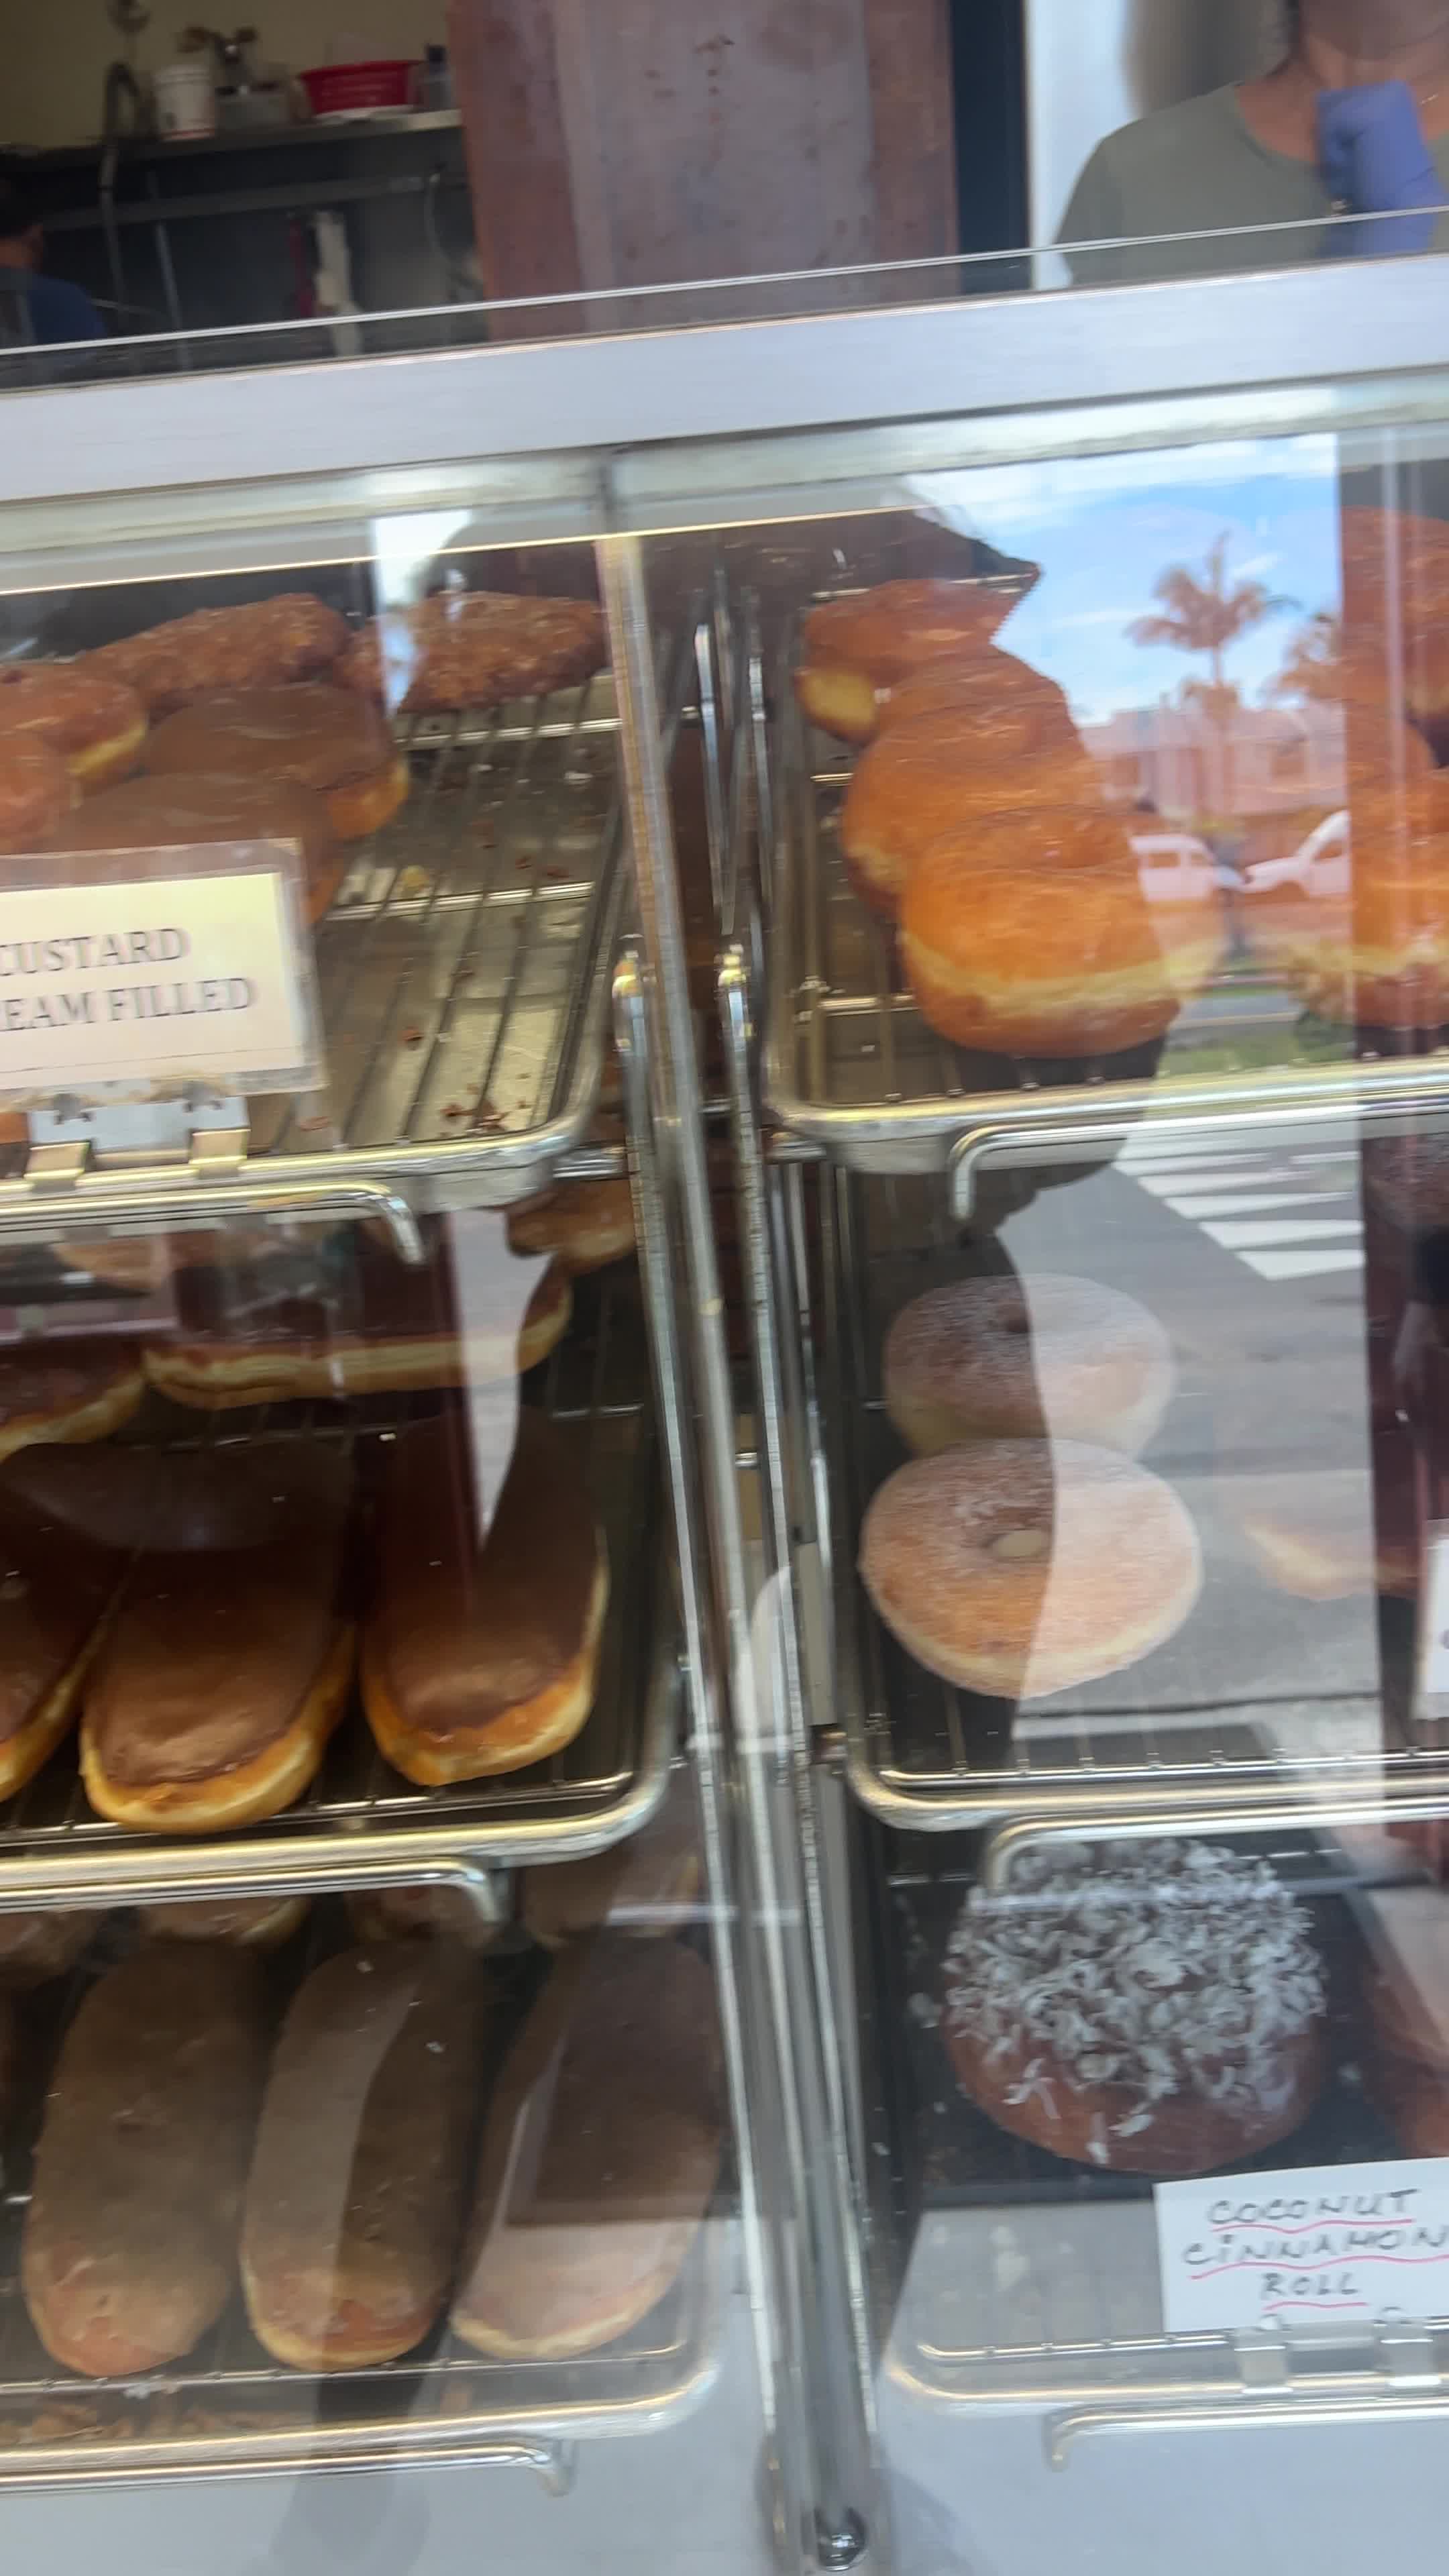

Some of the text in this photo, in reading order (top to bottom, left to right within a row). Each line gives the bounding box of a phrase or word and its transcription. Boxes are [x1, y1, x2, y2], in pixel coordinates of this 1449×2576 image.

[0, 977, 256, 1032] EAM FILLED
[1208, 2188, 1420, 2224] COCONUT
[1262, 2272, 1360, 2300] ROLL
